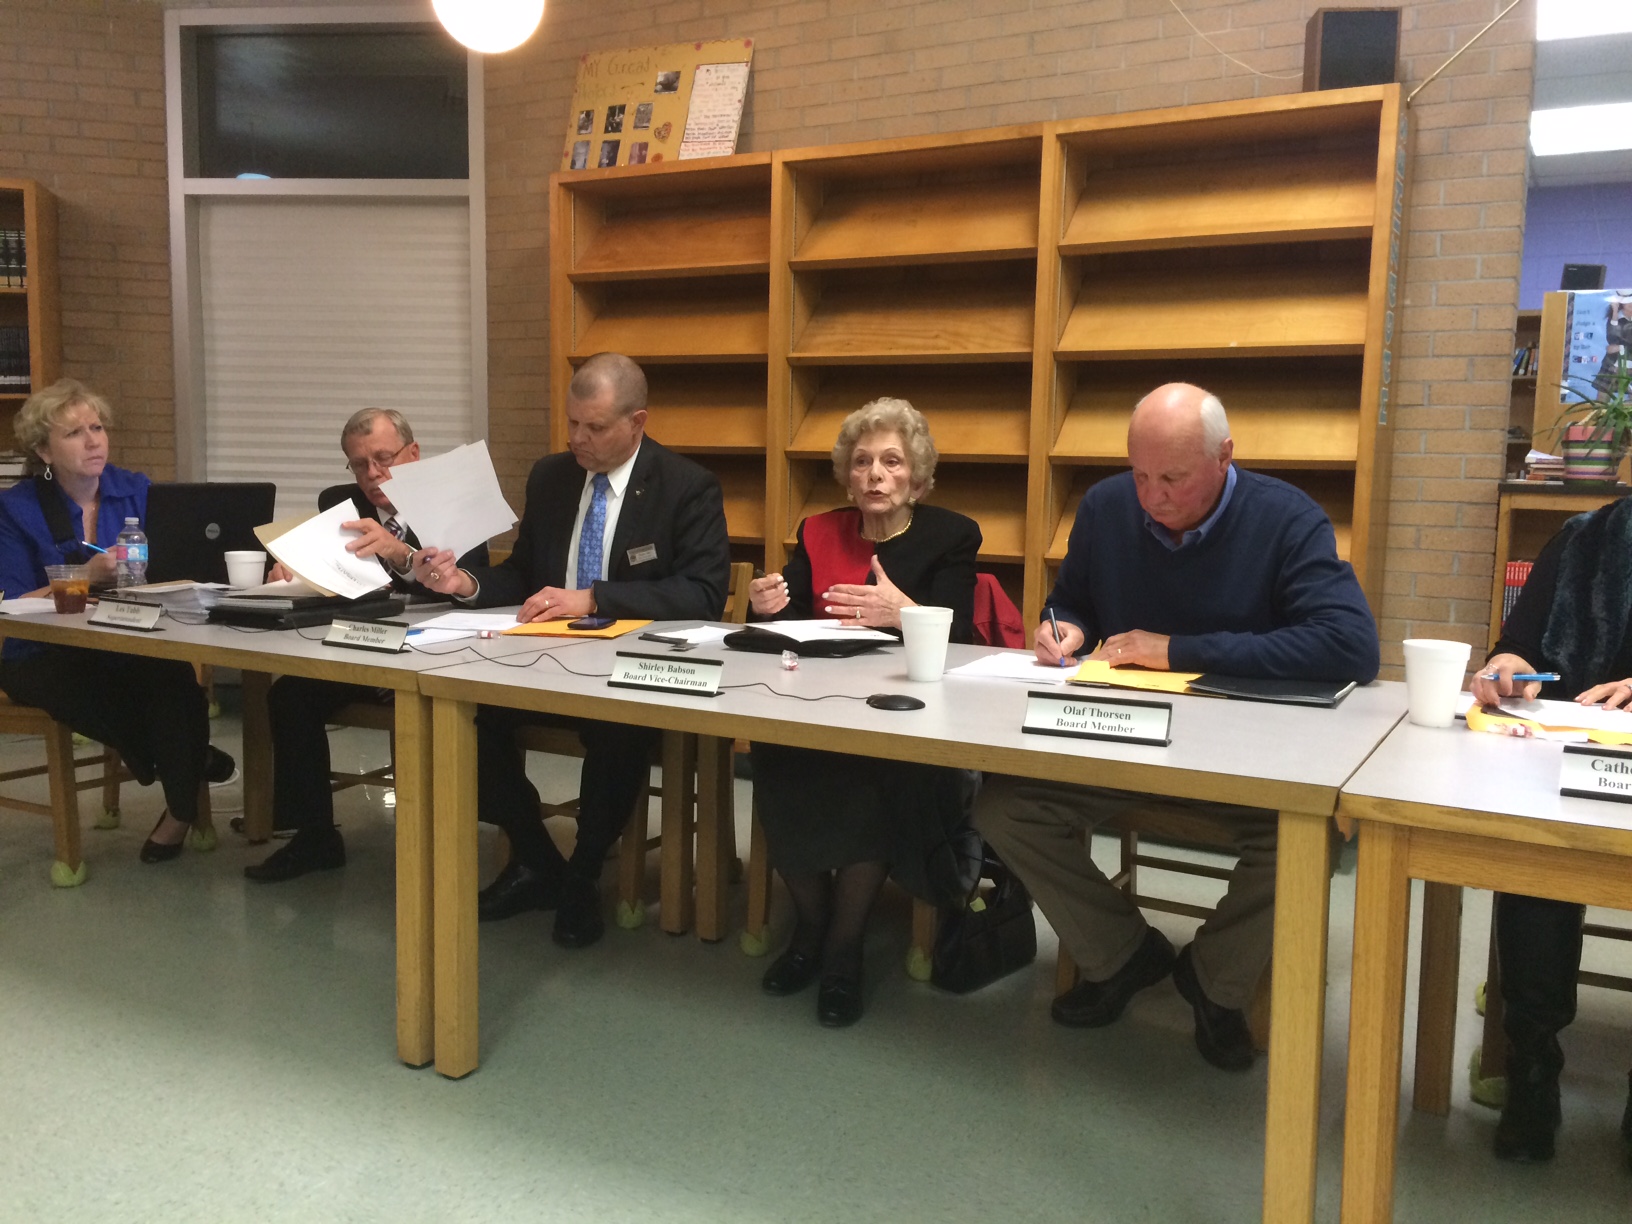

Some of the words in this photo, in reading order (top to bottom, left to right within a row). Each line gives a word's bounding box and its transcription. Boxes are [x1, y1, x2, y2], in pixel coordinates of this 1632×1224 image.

[1378, 112, 1408, 426] MAGAZINES
[348, 623, 370, 633] Charles
[371, 626, 388, 635] Miller
[343, 633, 361, 641] Board
[362, 635, 386, 644] Member
[638, 662, 665, 673] Shirley
[667, 664, 696, 675] Babson
[623, 672, 647, 681] Board
[650, 674, 708, 687] Vice-Chairman
[1063, 705, 1087, 716] Olaf
[1089, 708, 1132, 720] Thorsen
[1056, 718, 1088, 729] Board
[1091, 721, 1135, 734] Member
